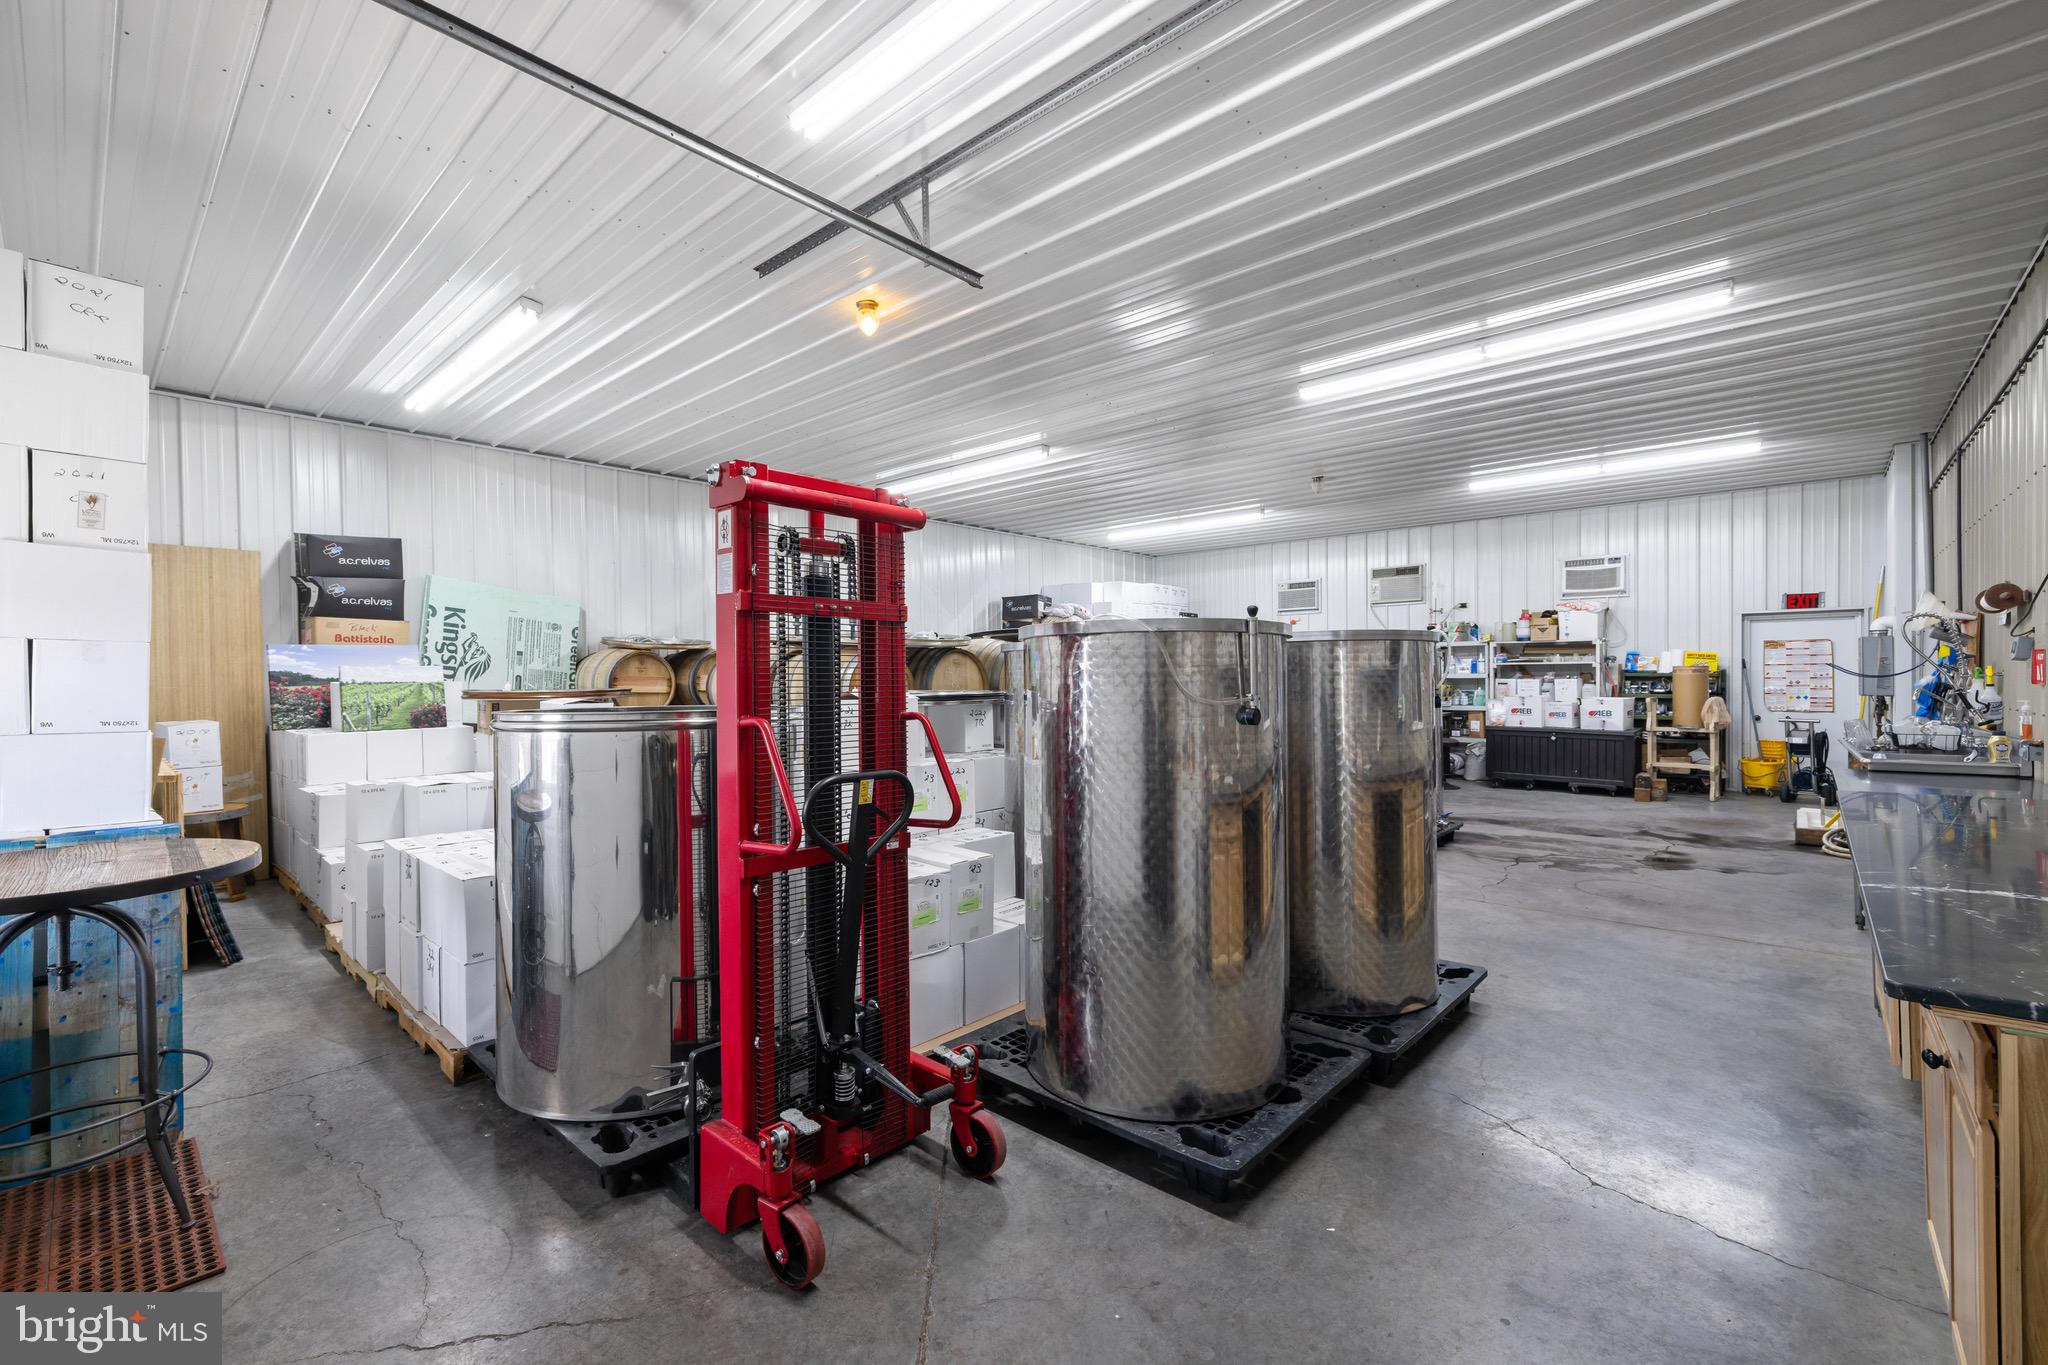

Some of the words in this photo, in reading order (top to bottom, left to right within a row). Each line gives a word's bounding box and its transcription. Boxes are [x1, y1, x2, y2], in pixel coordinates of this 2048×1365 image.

[1787, 594, 1818, 609] EXIT
[334, 633, 394, 644] Battistella
[435, 606, 466, 681] Kingsp
